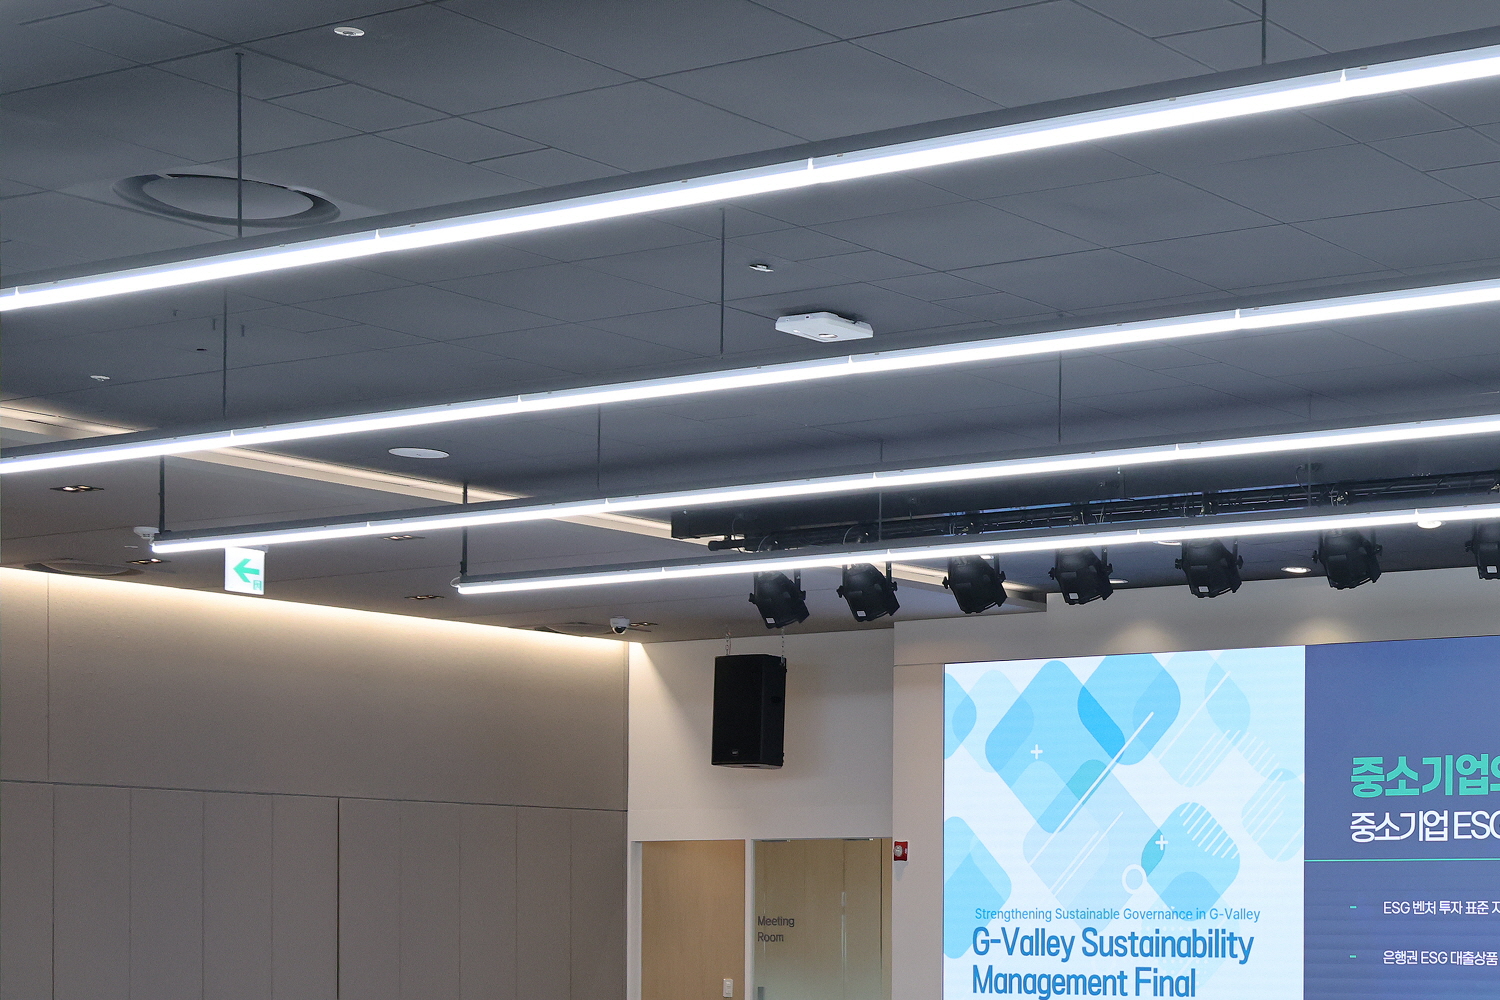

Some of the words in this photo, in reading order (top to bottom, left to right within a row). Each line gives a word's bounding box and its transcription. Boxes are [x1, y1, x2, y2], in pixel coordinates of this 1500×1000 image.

[1350, 809, 1449, 843] 중소기업
[975, 907, 1052, 923] Strengthening
[1054, 907, 1120, 921] Sustainable
[1123, 908, 1193, 921] Governance
[1195, 908, 1206, 920] in
[1209, 909, 1261, 924] G-Valley
[1383, 901, 1411, 914] ESG
[1412, 900, 1436, 915] 벤처
[1438, 900, 1463, 915] 투자
[1465, 901, 1489, 915] 표준
[757, 916, 795, 928] Meeting
[757, 932, 784, 942] Room
[972, 926, 1076, 962] G-Valley
[1081, 927, 1254, 965] Sustainability
[1383, 950, 1418, 964] 은행권
[1420, 951, 1448, 964] ESG
[1450, 950, 1498, 966] 대출상품
[972, 965, 1128, 1000] Management
[1135, 967, 1196, 997] Final
